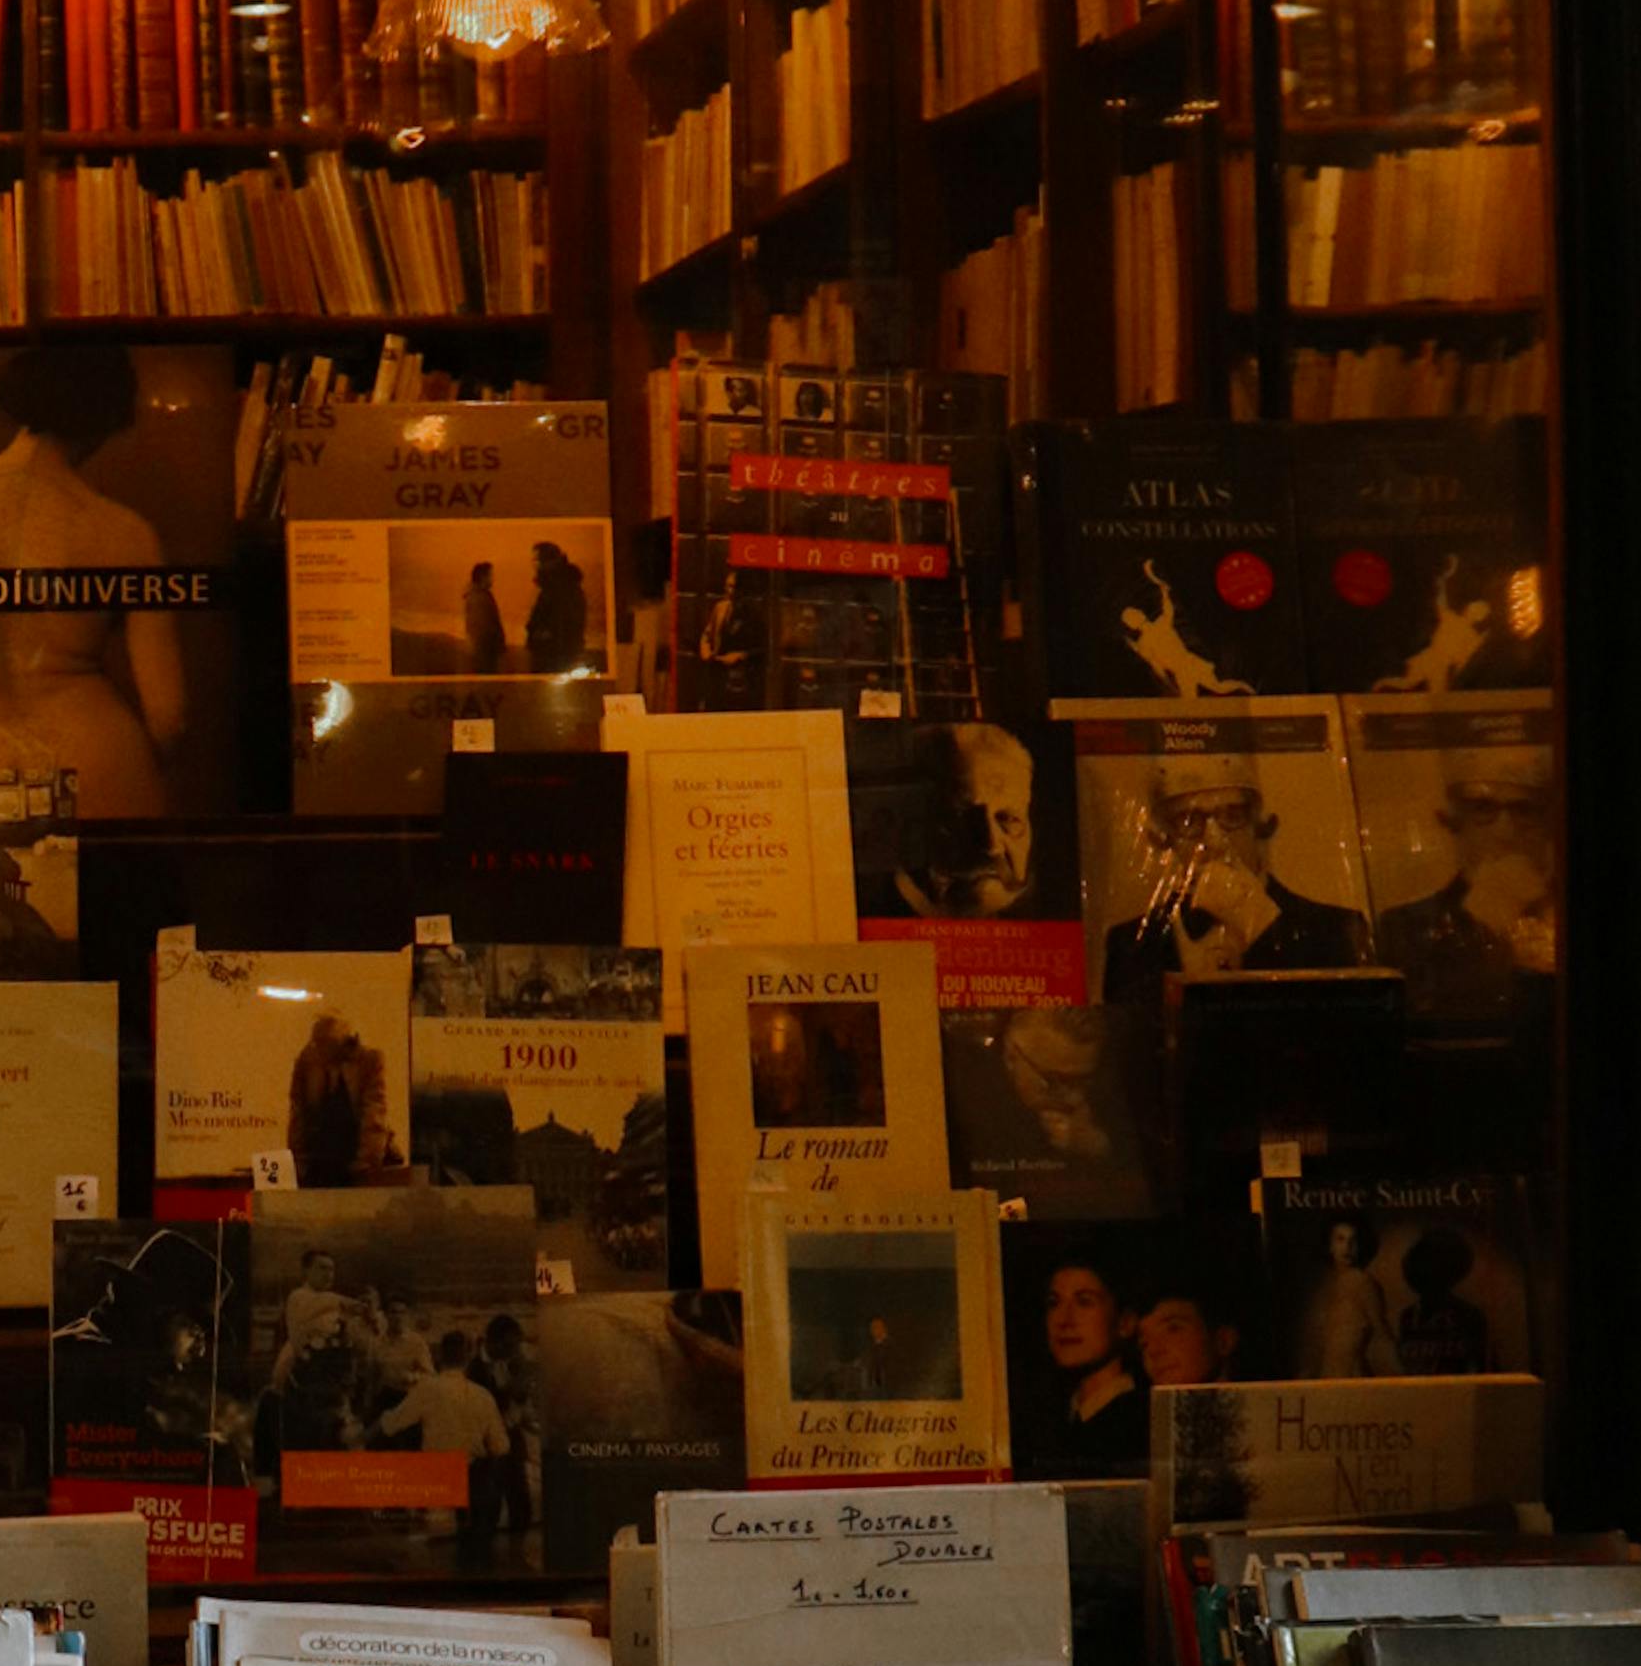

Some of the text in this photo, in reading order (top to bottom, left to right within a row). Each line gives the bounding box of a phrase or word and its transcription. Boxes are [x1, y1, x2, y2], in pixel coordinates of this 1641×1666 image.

[384, 445, 502, 473] JAMES
[743, 459, 937, 496] théâtres
[395, 482, 491, 509] GRAY
[1122, 479, 1235, 508] ATLAS
[743, 538, 935, 574] cinéma
[1162, 721, 1217, 737] Woody
[1164, 737, 1205, 752] Allen
[686, 804, 773, 835] Orgies
[674, 839, 697, 862] et
[745, 972, 881, 998] JEAN CAU
[943, 975, 1047, 994] DU NOUVEAU
[499, 1043, 578, 1072] 1900
[168, 1090, 243, 1109] Dino Risi
[168, 1109, 278, 1130] Mes monstres
[757, 1131, 890, 1162] Le roman
[811, 1167, 840, 1193] de
[1283, 1179, 1366, 1211] Renée
[798, 1409, 958, 1439] Les Chagrins
[1275, 1395, 1414, 1453] Hommes
[645, 1441, 721, 1459] PAYSAGES
[771, 1442, 987, 1470] du Prince Charles
[1369, 1453, 1401, 1480] en
[132, 1495, 184, 1519] PRIX
[837, 1505, 955, 1532] POSTALES
[143, 1518, 247, 1546] SFUGE
[308, 1634, 547, 1665] décoration de la maison
